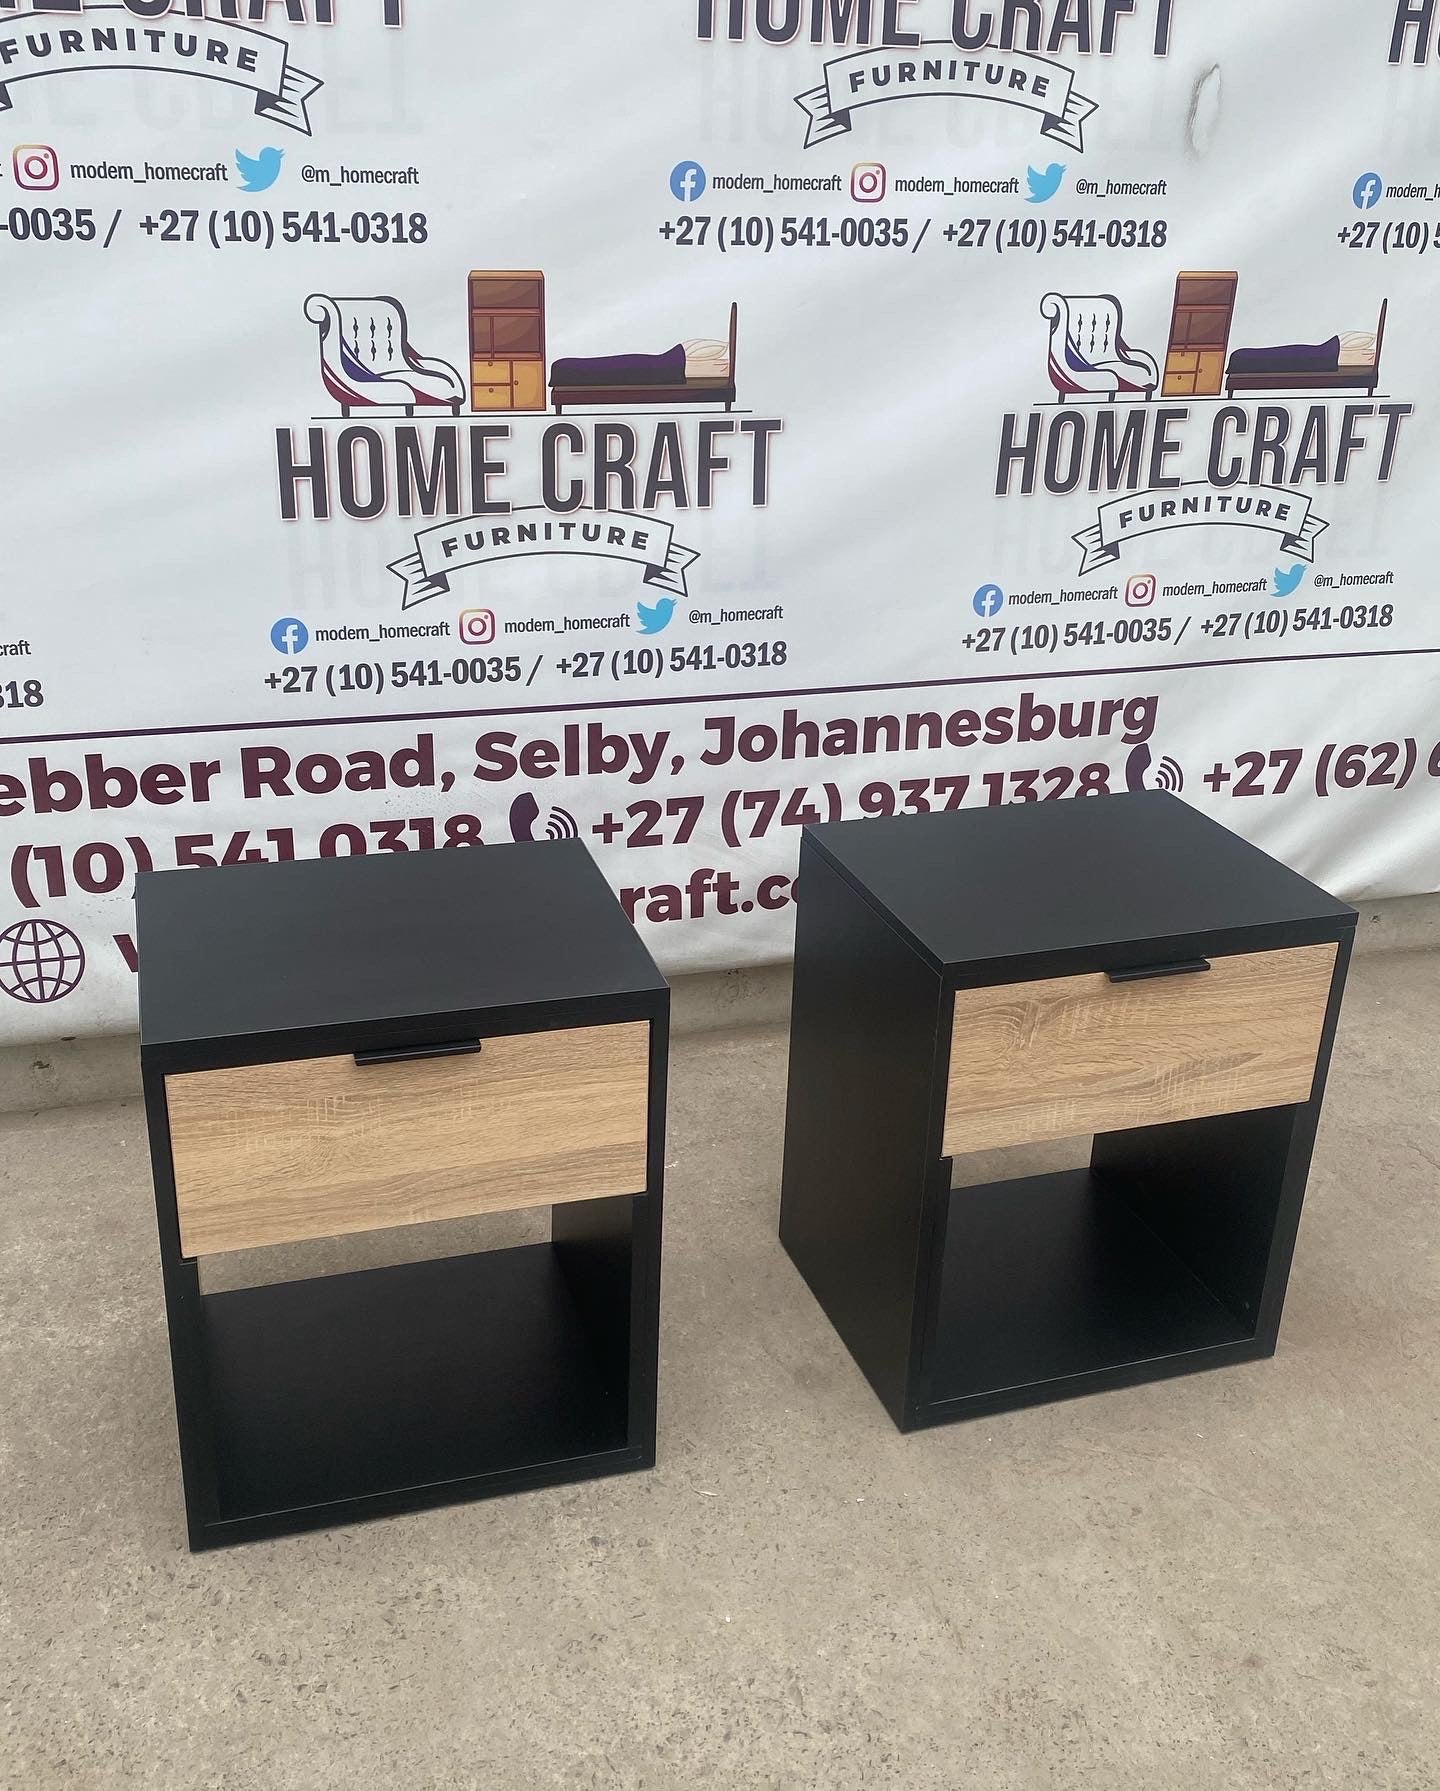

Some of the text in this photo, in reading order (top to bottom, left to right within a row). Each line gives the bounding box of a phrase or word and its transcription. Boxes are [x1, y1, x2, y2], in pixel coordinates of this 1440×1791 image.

[0, 26, 262, 75] FURNITURE
[848, 58, 1051, 99] FURNITURE
[300, 163, 421, 187] @m_homecraft
[1074, 177, 1168, 198] @m_homecraft
[138, 208, 200, 243] +27
[207, 208, 275, 250] (10)
[281, 209, 429, 245] 541-0318
[658, 214, 712, 247] +27
[716, 215, 774, 254] (10)
[780, 216, 909, 248] 541-0035
[942, 217, 991, 248] +27
[995, 218, 1048, 254] (10)
[1051, 218, 1168, 249] 541-0318
[1337, 221, 1381, 249] +27
[1382, 221, 1430, 255] (10)
[274, 417, 784, 521] HOME CRAFT
[993, 402, 1414, 498] HOME CRAFT
[1118, 494, 1293, 530] FURNITURE
[442, 521, 651, 559] FURNITURE
[1313, 570, 1395, 590] @m_homecraft
[688, 605, 784, 626] @m_homecraft
[962, 627, 1006, 655] +27
[1010, 623, 1059, 655] (10)
[1063, 615, 1172, 648] 541-0035
[1200, 612, 1243, 638] +27
[1244, 608, 1290, 638] (10)
[1292, 603, 1394, 632] 541-0318
[264, 665, 318, 695] +27
[325, 662, 385, 698] (10)
[391, 655, 522, 689] 541-0035
[555, 651, 606, 680] +27
[611, 648, 663, 682] (10)
[668, 640, 788, 674] 541-0318
[240, 732, 457, 799] Road,
[472, 721, 686, 785] Selby,
[700, 694, 1160, 767] Johannesburg
[174, 827, 295, 867] 541
[318, 812, 486, 859] 0318
[591, 795, 706, 849] +27
[720, 782, 843, 848] (74)
[858, 774, 970, 818] 937
[982, 762, 1111, 808] 1328
[1202, 748, 1304, 798] +27
[1315, 737, 1418, 798] (62)
